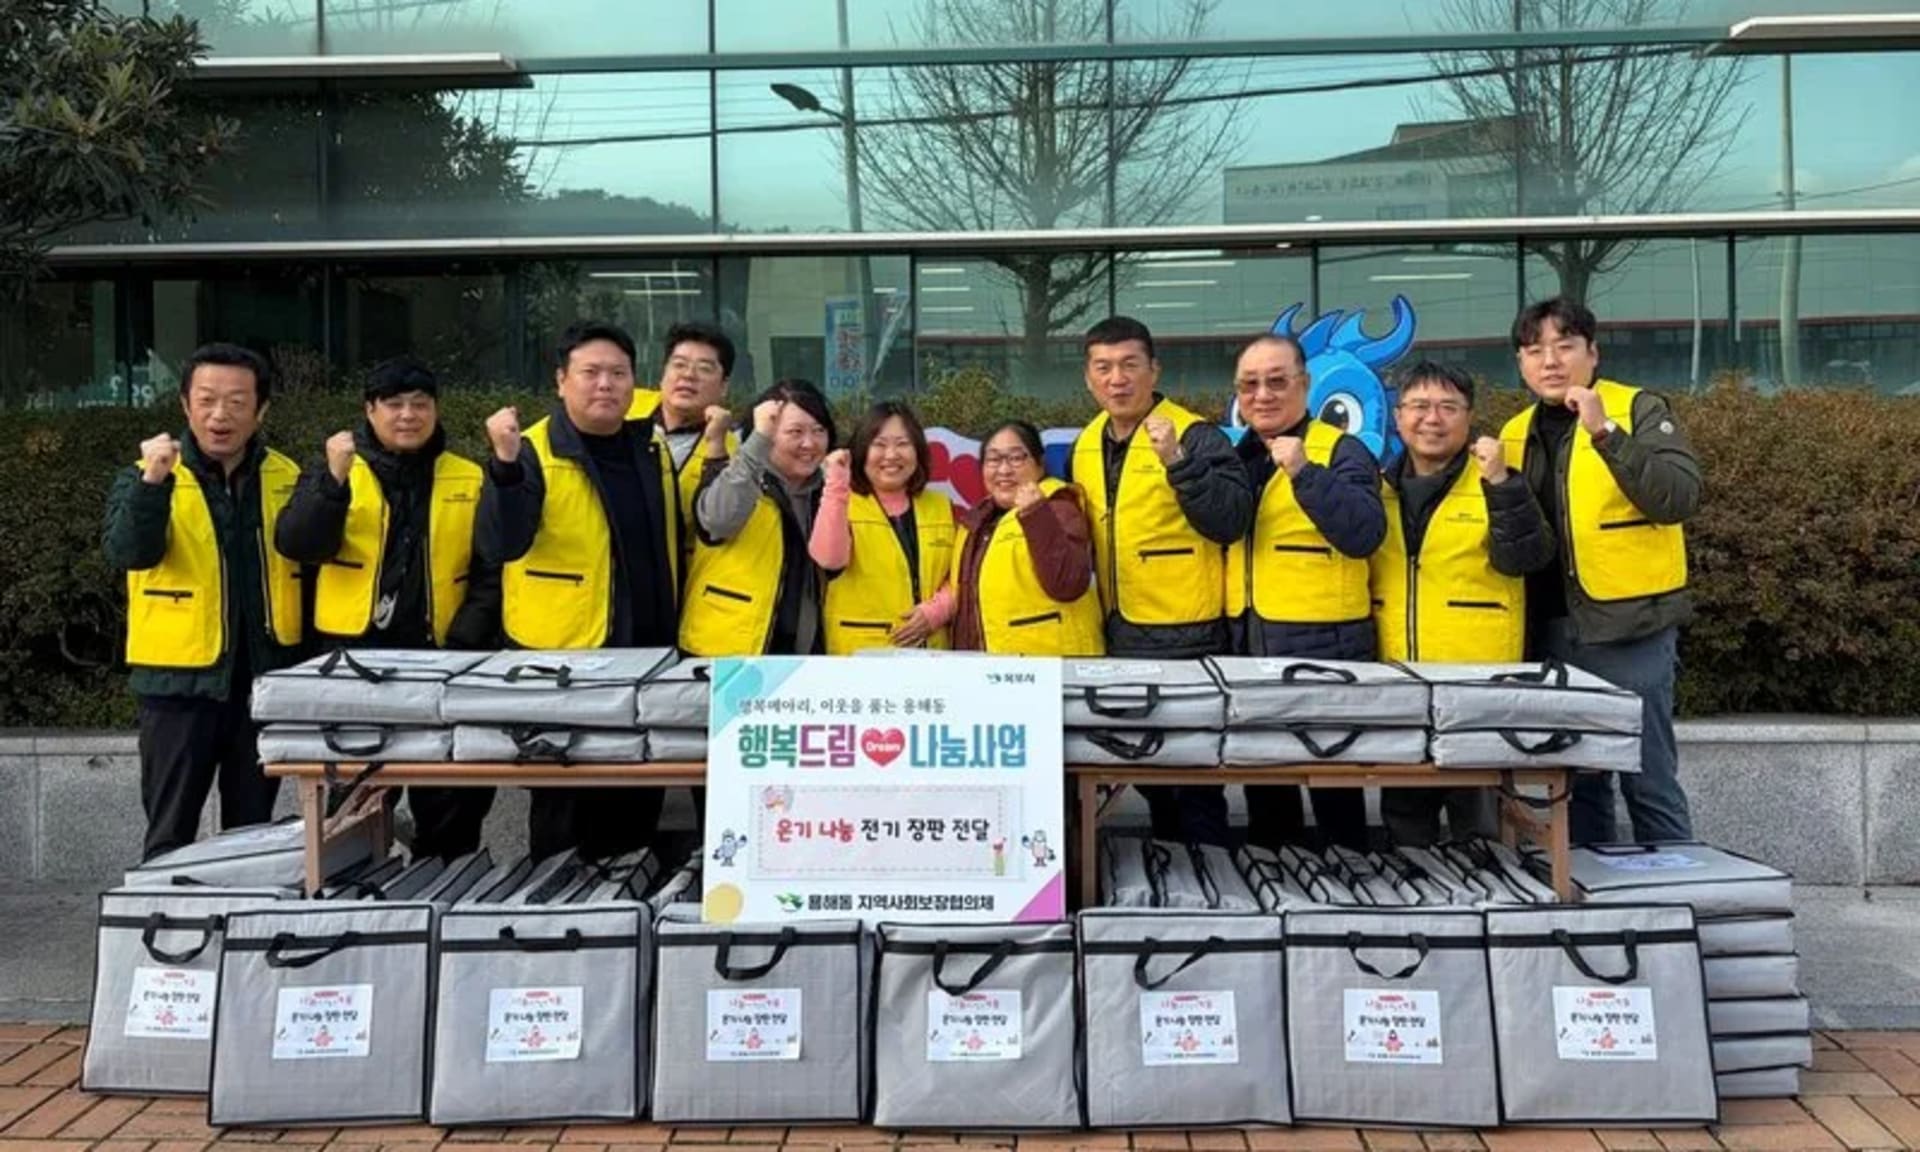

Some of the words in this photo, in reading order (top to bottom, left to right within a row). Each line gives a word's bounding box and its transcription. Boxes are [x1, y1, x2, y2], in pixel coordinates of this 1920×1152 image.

[820, 698, 863, 714] 이웃을
[903, 698, 946, 714] 용해동
[738, 723, 855, 768] 행복드림
[866, 741, 900, 751] Dream
[910, 723, 1026, 768] 나눔사업
[776, 818, 812, 843] 온기
[818, 818, 855, 843] 나눔
[861, 818, 901, 842] 전기
[907, 818, 946, 842] 장판
[952, 818, 990, 842] 전달
[808, 894, 853, 910] 용해동
[858, 894, 994, 910] 지역사회보장협의체
